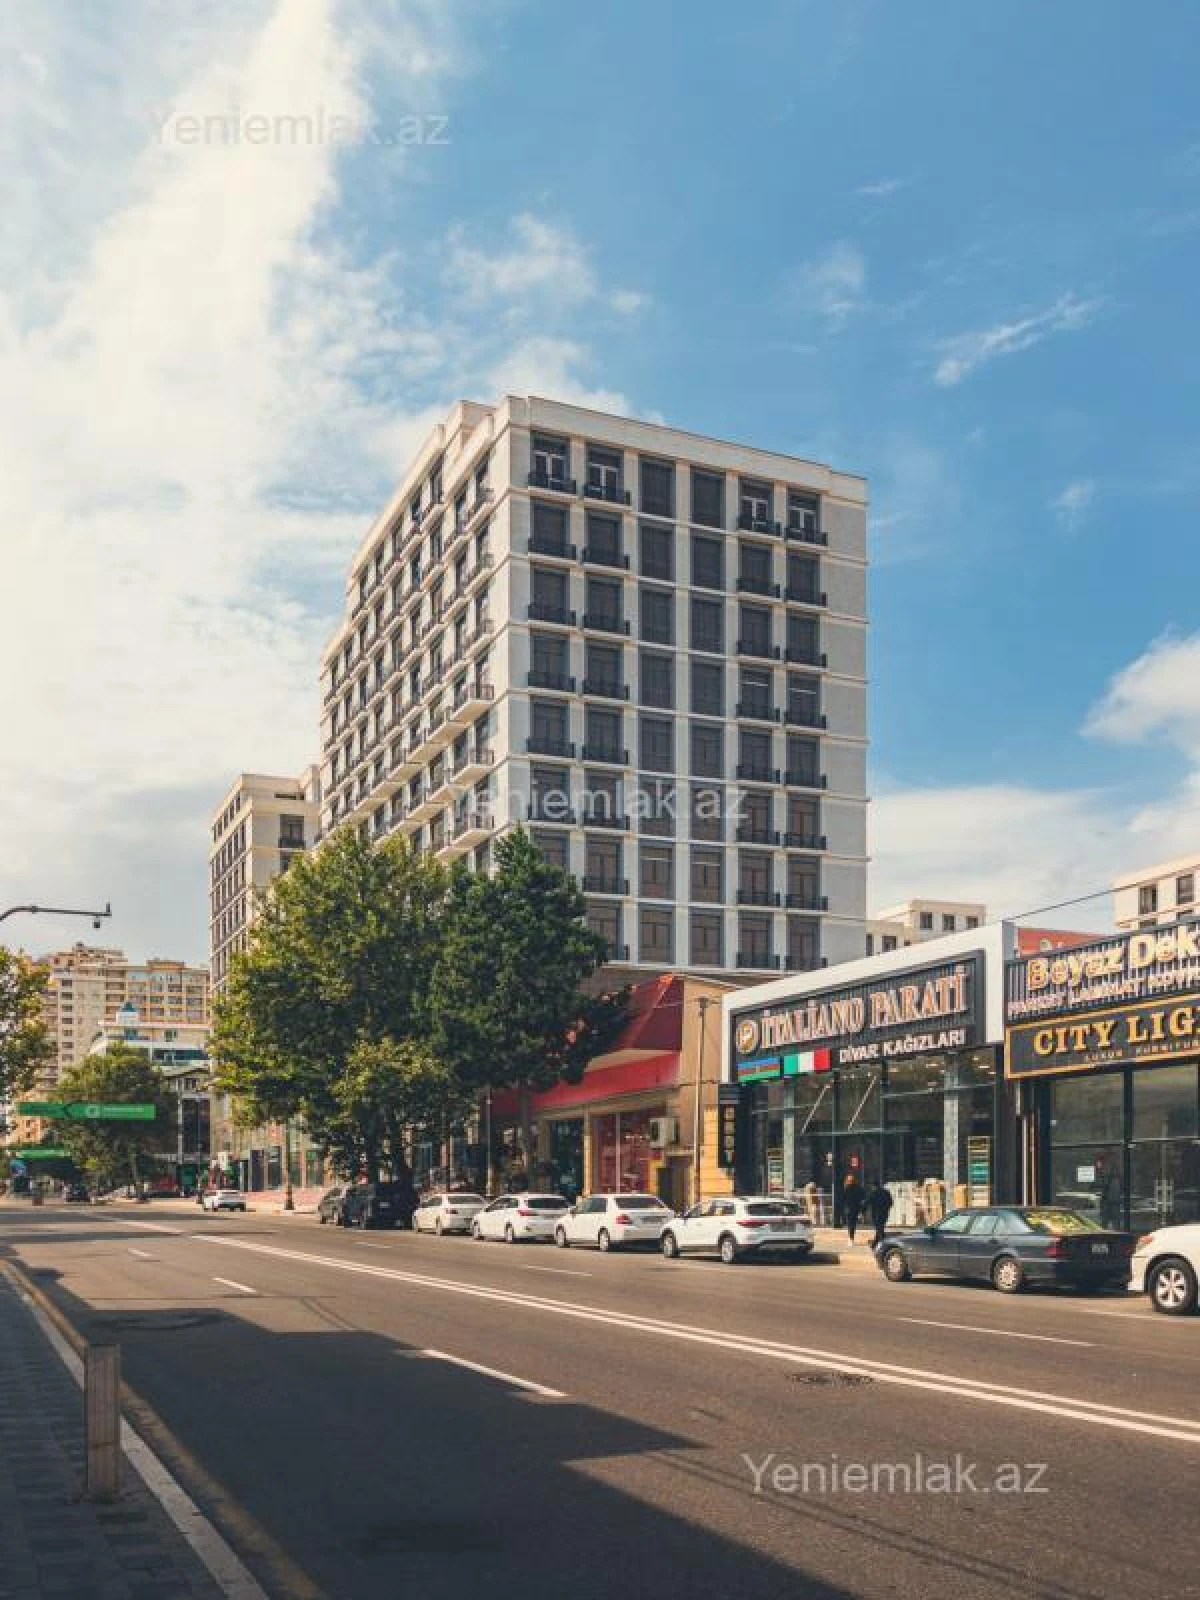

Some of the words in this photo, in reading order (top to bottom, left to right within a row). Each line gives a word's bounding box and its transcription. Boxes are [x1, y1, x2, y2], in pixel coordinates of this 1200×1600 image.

[1027, 946, 1124, 991] Beyaz
[839, 1043, 879, 1063] DİVAR
[1033, 1020, 1115, 1055] CITY
[1127, 1006, 1200, 1043] LIG
